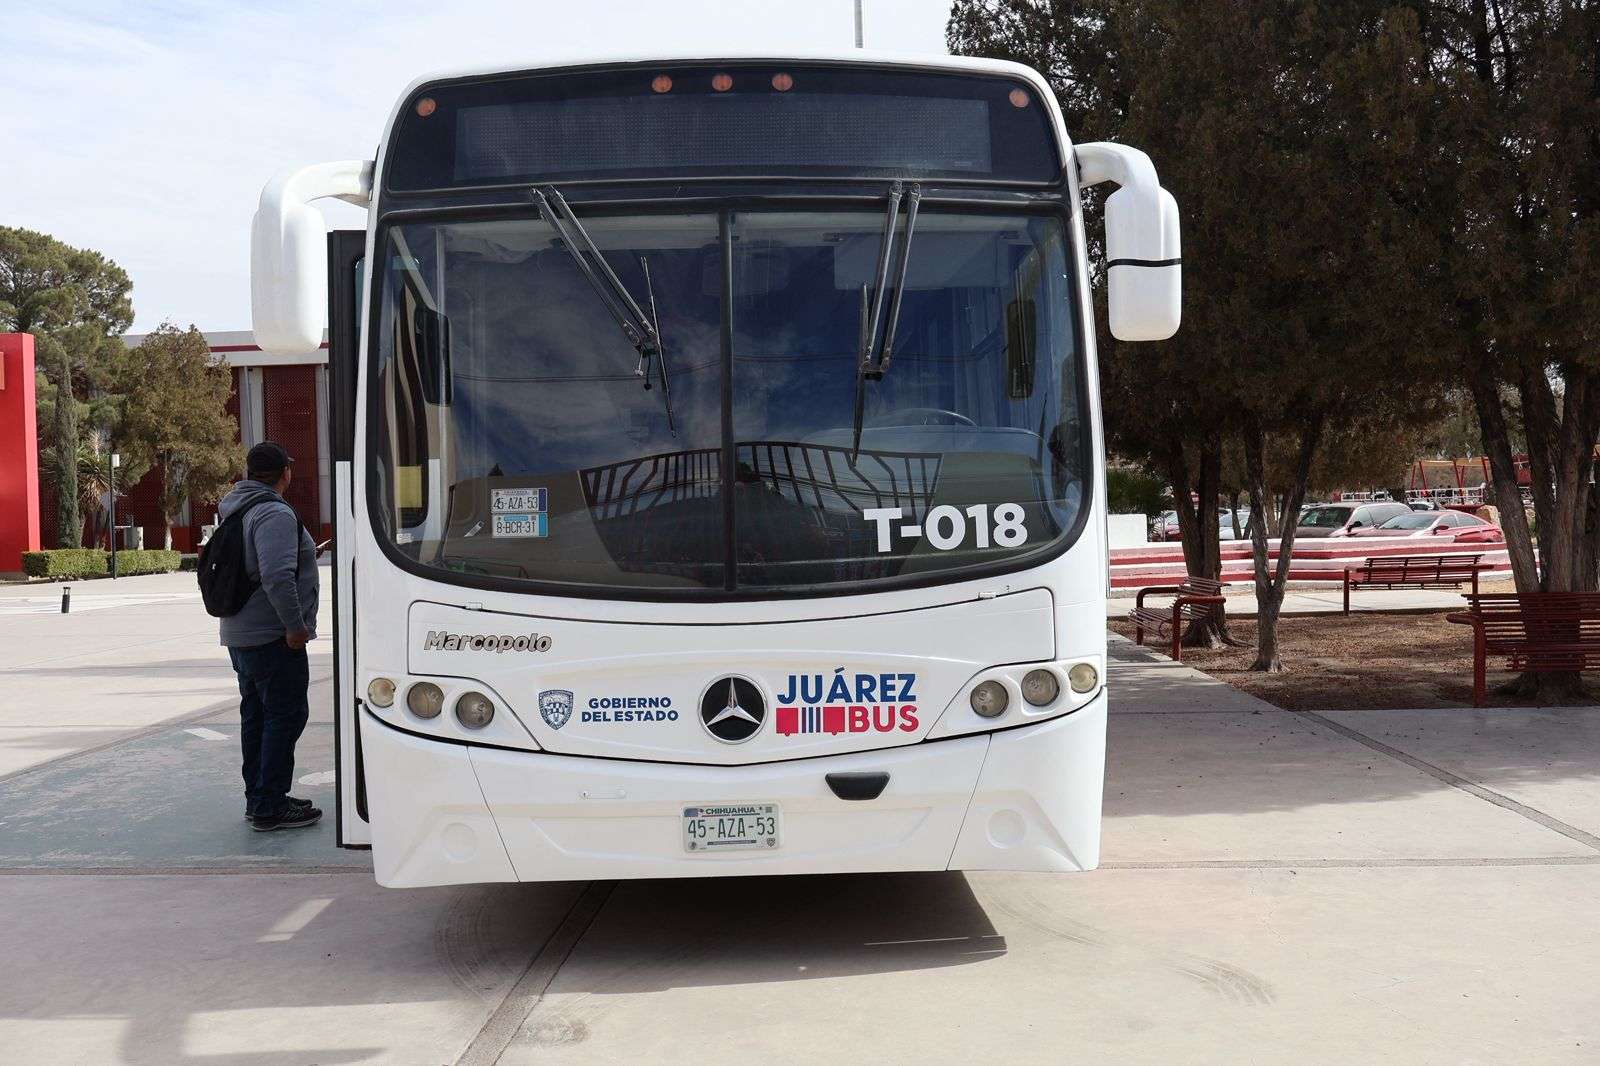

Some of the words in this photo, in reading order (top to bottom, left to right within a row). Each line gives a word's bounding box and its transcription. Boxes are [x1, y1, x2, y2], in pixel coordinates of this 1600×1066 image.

[493, 496, 538, 510] 45-AZA-53
[863, 502, 1028, 553] T-018
[423, 630, 553, 654] Marcopolo
[777, 666, 917, 704] JUÁREZ
[588, 696, 672, 709] GOBIERNO
[581, 711, 612, 723] DEL
[614, 710, 679, 722] ESTADO
[848, 704, 919, 732] BUS
[705, 806, 756, 815] CHIHUAHUA
[688, 817, 775, 839] 45-AZA-53
